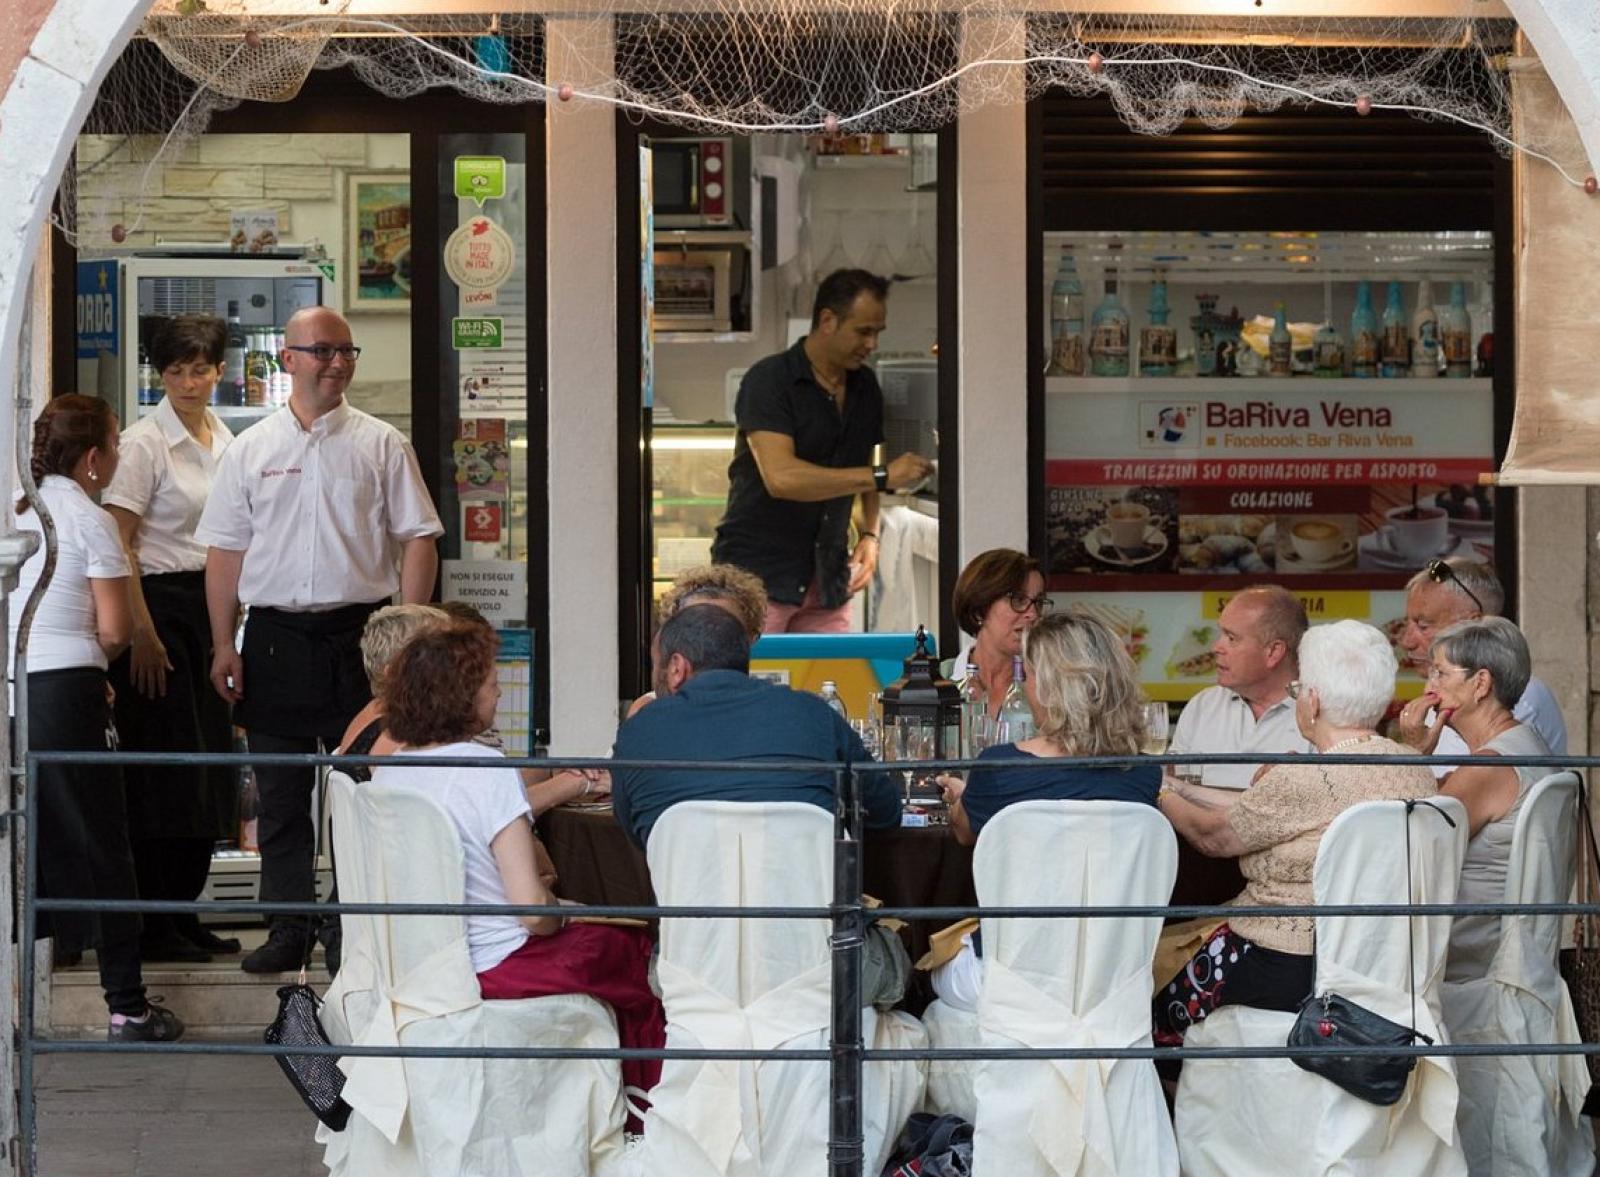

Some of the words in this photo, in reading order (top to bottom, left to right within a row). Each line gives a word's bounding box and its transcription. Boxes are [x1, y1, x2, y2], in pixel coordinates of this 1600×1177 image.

[470, 251, 489, 260] MADE
[475, 260, 494, 270] ITALY
[1206, 402, 1310, 428] BaRiva
[1319, 402, 1392, 428] Vena
[1224, 433, 1303, 447] Facebook:
[1307, 433, 1332, 447] Bar
[1338, 433, 1372, 447] Riva
[1377, 433, 1414, 447] Vena
[1102, 463, 1198, 480] TRAMEZZINI
[1202, 463, 1222, 479] SU
[1227, 463, 1330, 479] ORDINAZIONE
[1335, 463, 1363, 478] PER
[1369, 462, 1438, 478] ASPORTO
[1230, 491, 1314, 508] COLAZIONE
[450, 572, 470, 581] NON
[473, 572, 481, 581] SI
[482, 572, 514, 581] ESEGUE
[458, 588, 497, 597] SERVIZIO
[499, 588, 510, 597] AL
